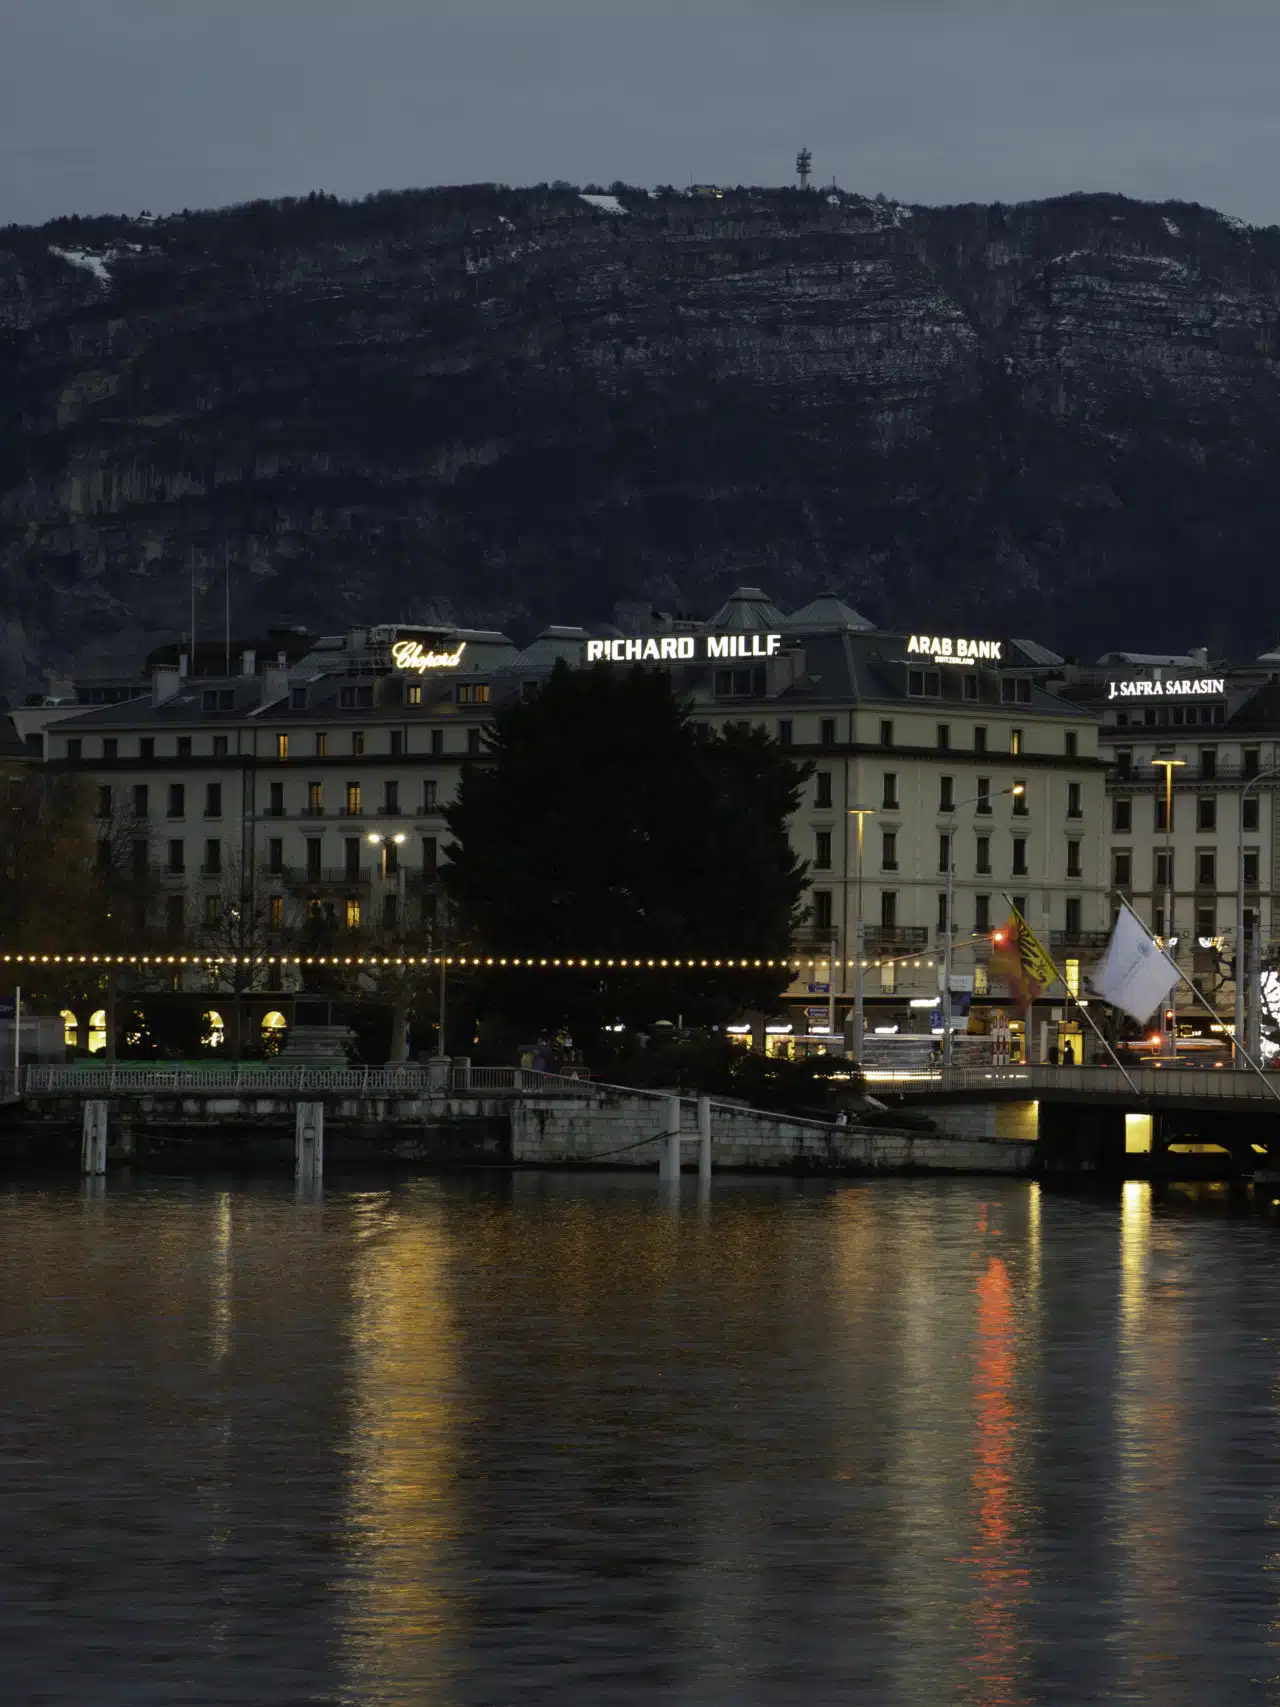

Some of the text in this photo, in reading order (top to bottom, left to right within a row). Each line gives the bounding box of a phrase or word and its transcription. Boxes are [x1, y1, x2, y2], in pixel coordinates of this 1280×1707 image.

[392, 641, 466, 674] Chopard
[587, 634, 781, 662] RICHARD MILLE
[907, 635, 1001, 659] ARAB BANK
[1108, 679, 1224, 699] J. SAFRA SARASIN
